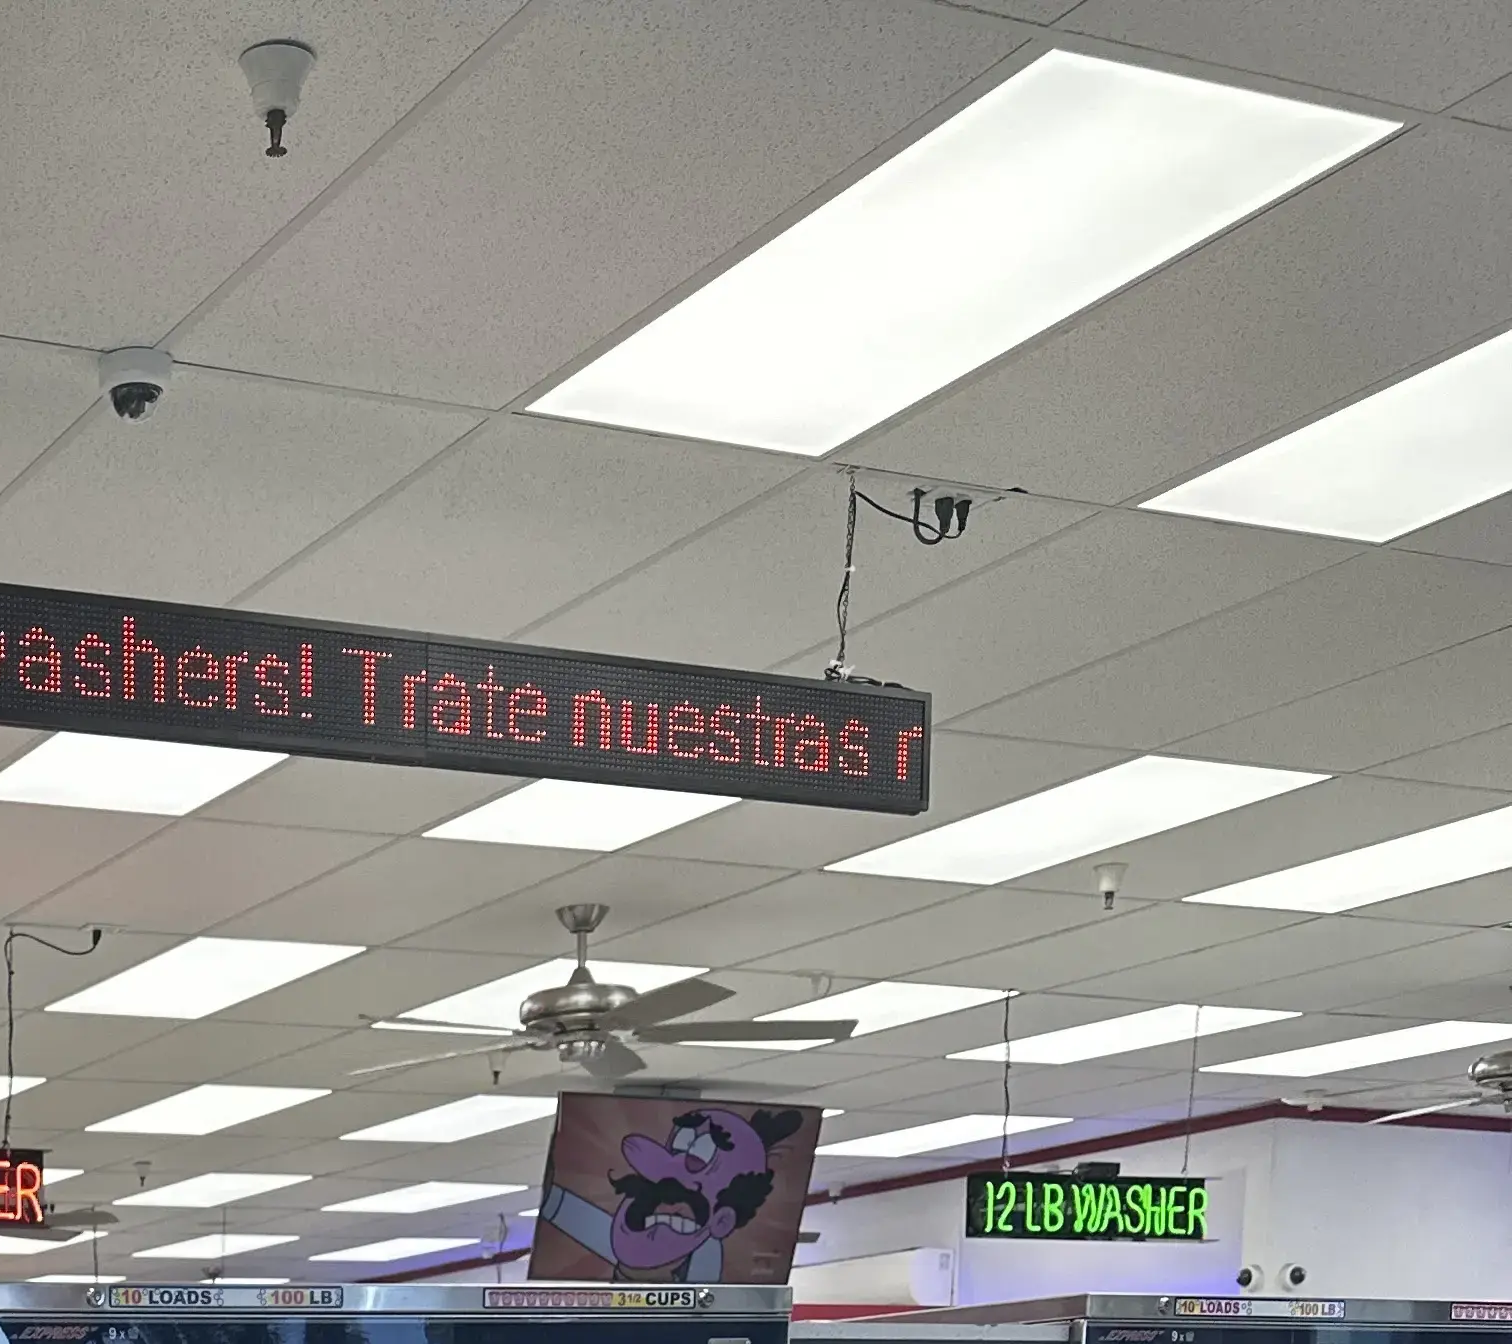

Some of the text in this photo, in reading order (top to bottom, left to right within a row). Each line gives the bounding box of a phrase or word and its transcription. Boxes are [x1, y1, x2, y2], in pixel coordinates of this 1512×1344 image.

[341, 646, 547, 743] Trate
[571, 689, 869, 778] nuestras
[985, 1181, 1208, 1239] 12 LB WASHER
[120, 1289, 213, 1306] 10 LOADS
[270, 1290, 334, 1306] 100 LB
[645, 1291, 692, 1307] CUPS
[1179, 1301, 1240, 1315] 10 LOADS
[1299, 1302, 1336, 1316] 100 LB
[108, 1327, 117, 1340] 9
[1171, 1330, 1179, 1342] 9
